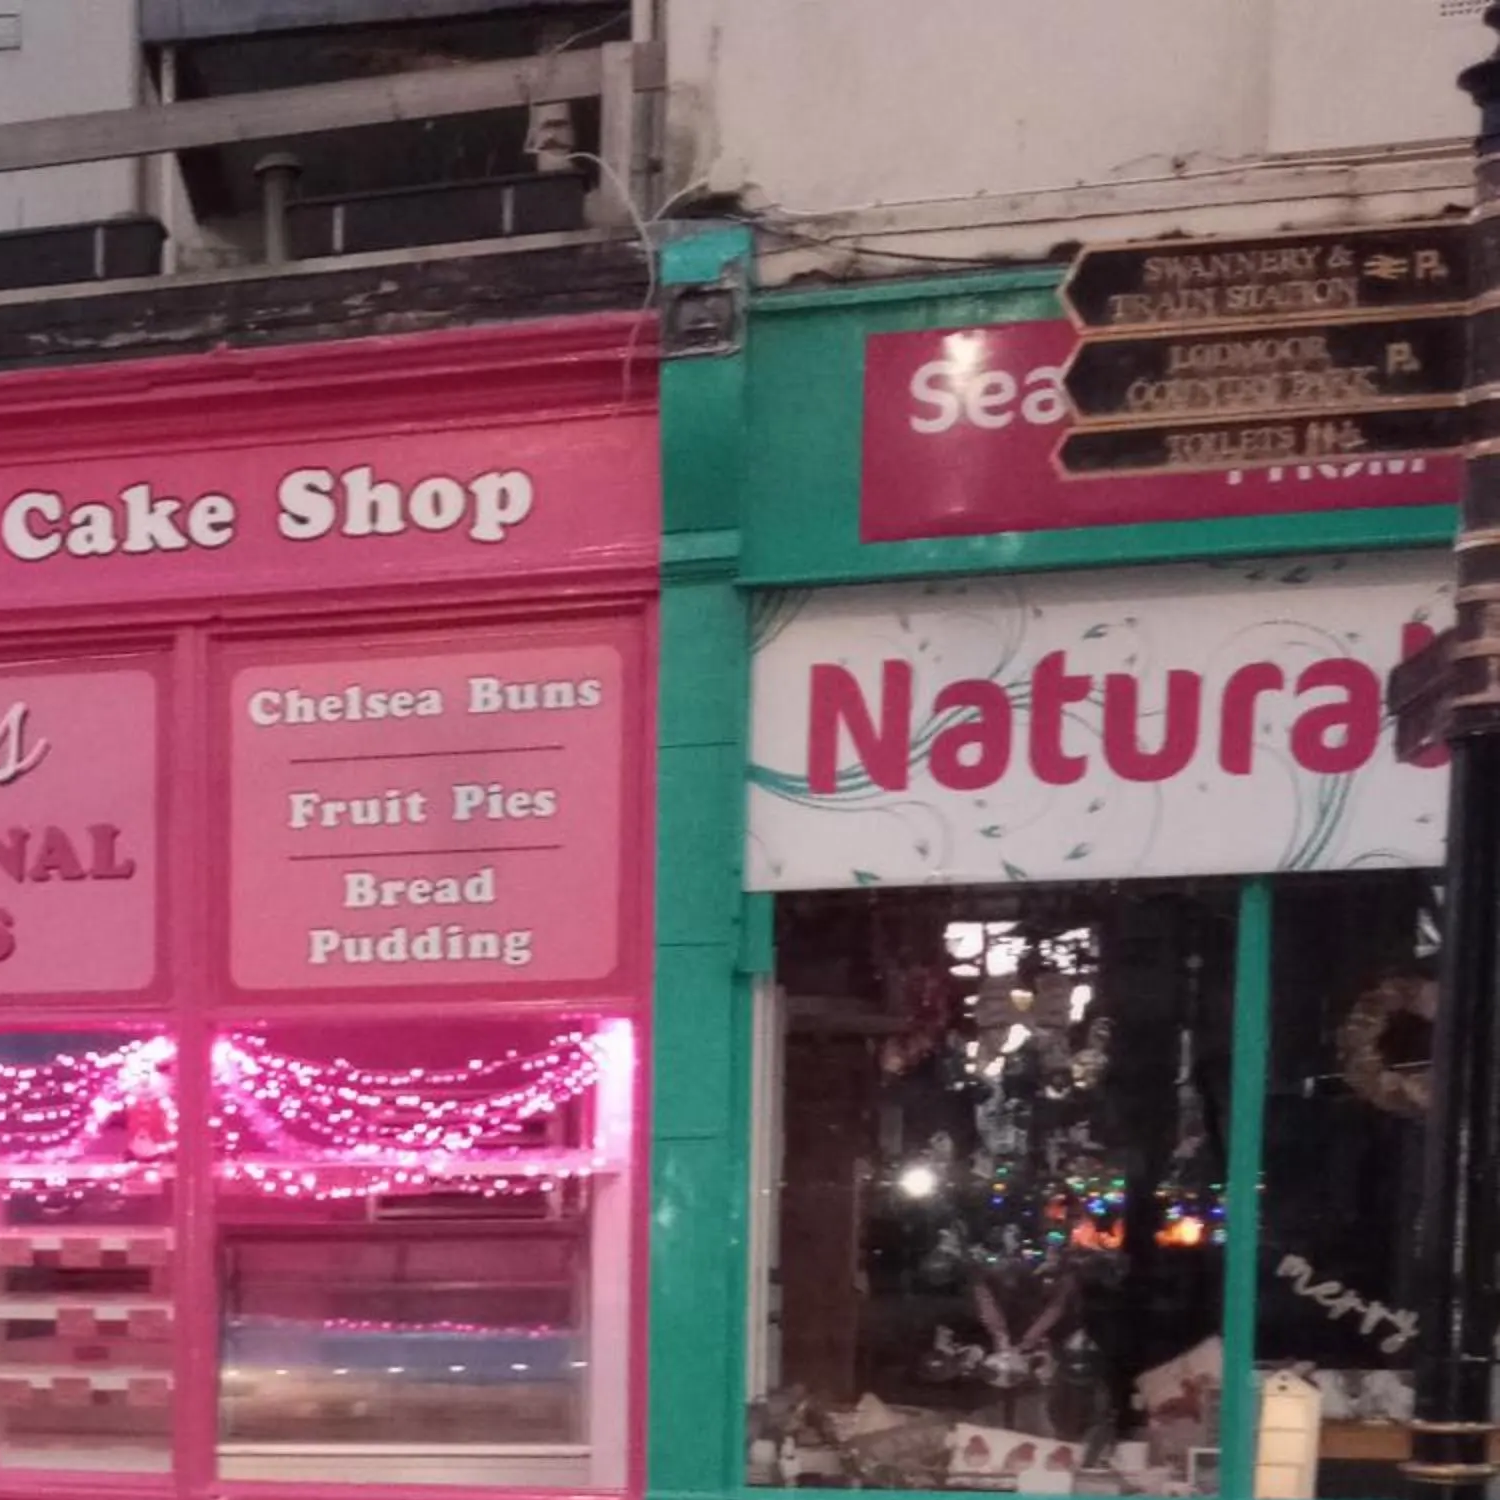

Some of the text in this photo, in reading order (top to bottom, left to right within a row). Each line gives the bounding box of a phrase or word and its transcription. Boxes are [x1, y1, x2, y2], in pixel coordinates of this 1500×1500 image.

[1143, 246, 1321, 282] SWANNERY
[1327, 243, 1356, 268] &
[1108, 277, 1359, 325] TRAIN STATION
[1126, 366, 1379, 411] COUNTRY PARK
[1166, 426, 1296, 460] TOILETS
[1, 483, 236, 562] Cake
[277, 465, 535, 542] Shop
[249, 676, 603, 726] Chelsea Buns
[288, 784, 557, 829] Fruit Pies
[343, 868, 498, 909] Bread
[308, 928, 534, 966] Pudding
